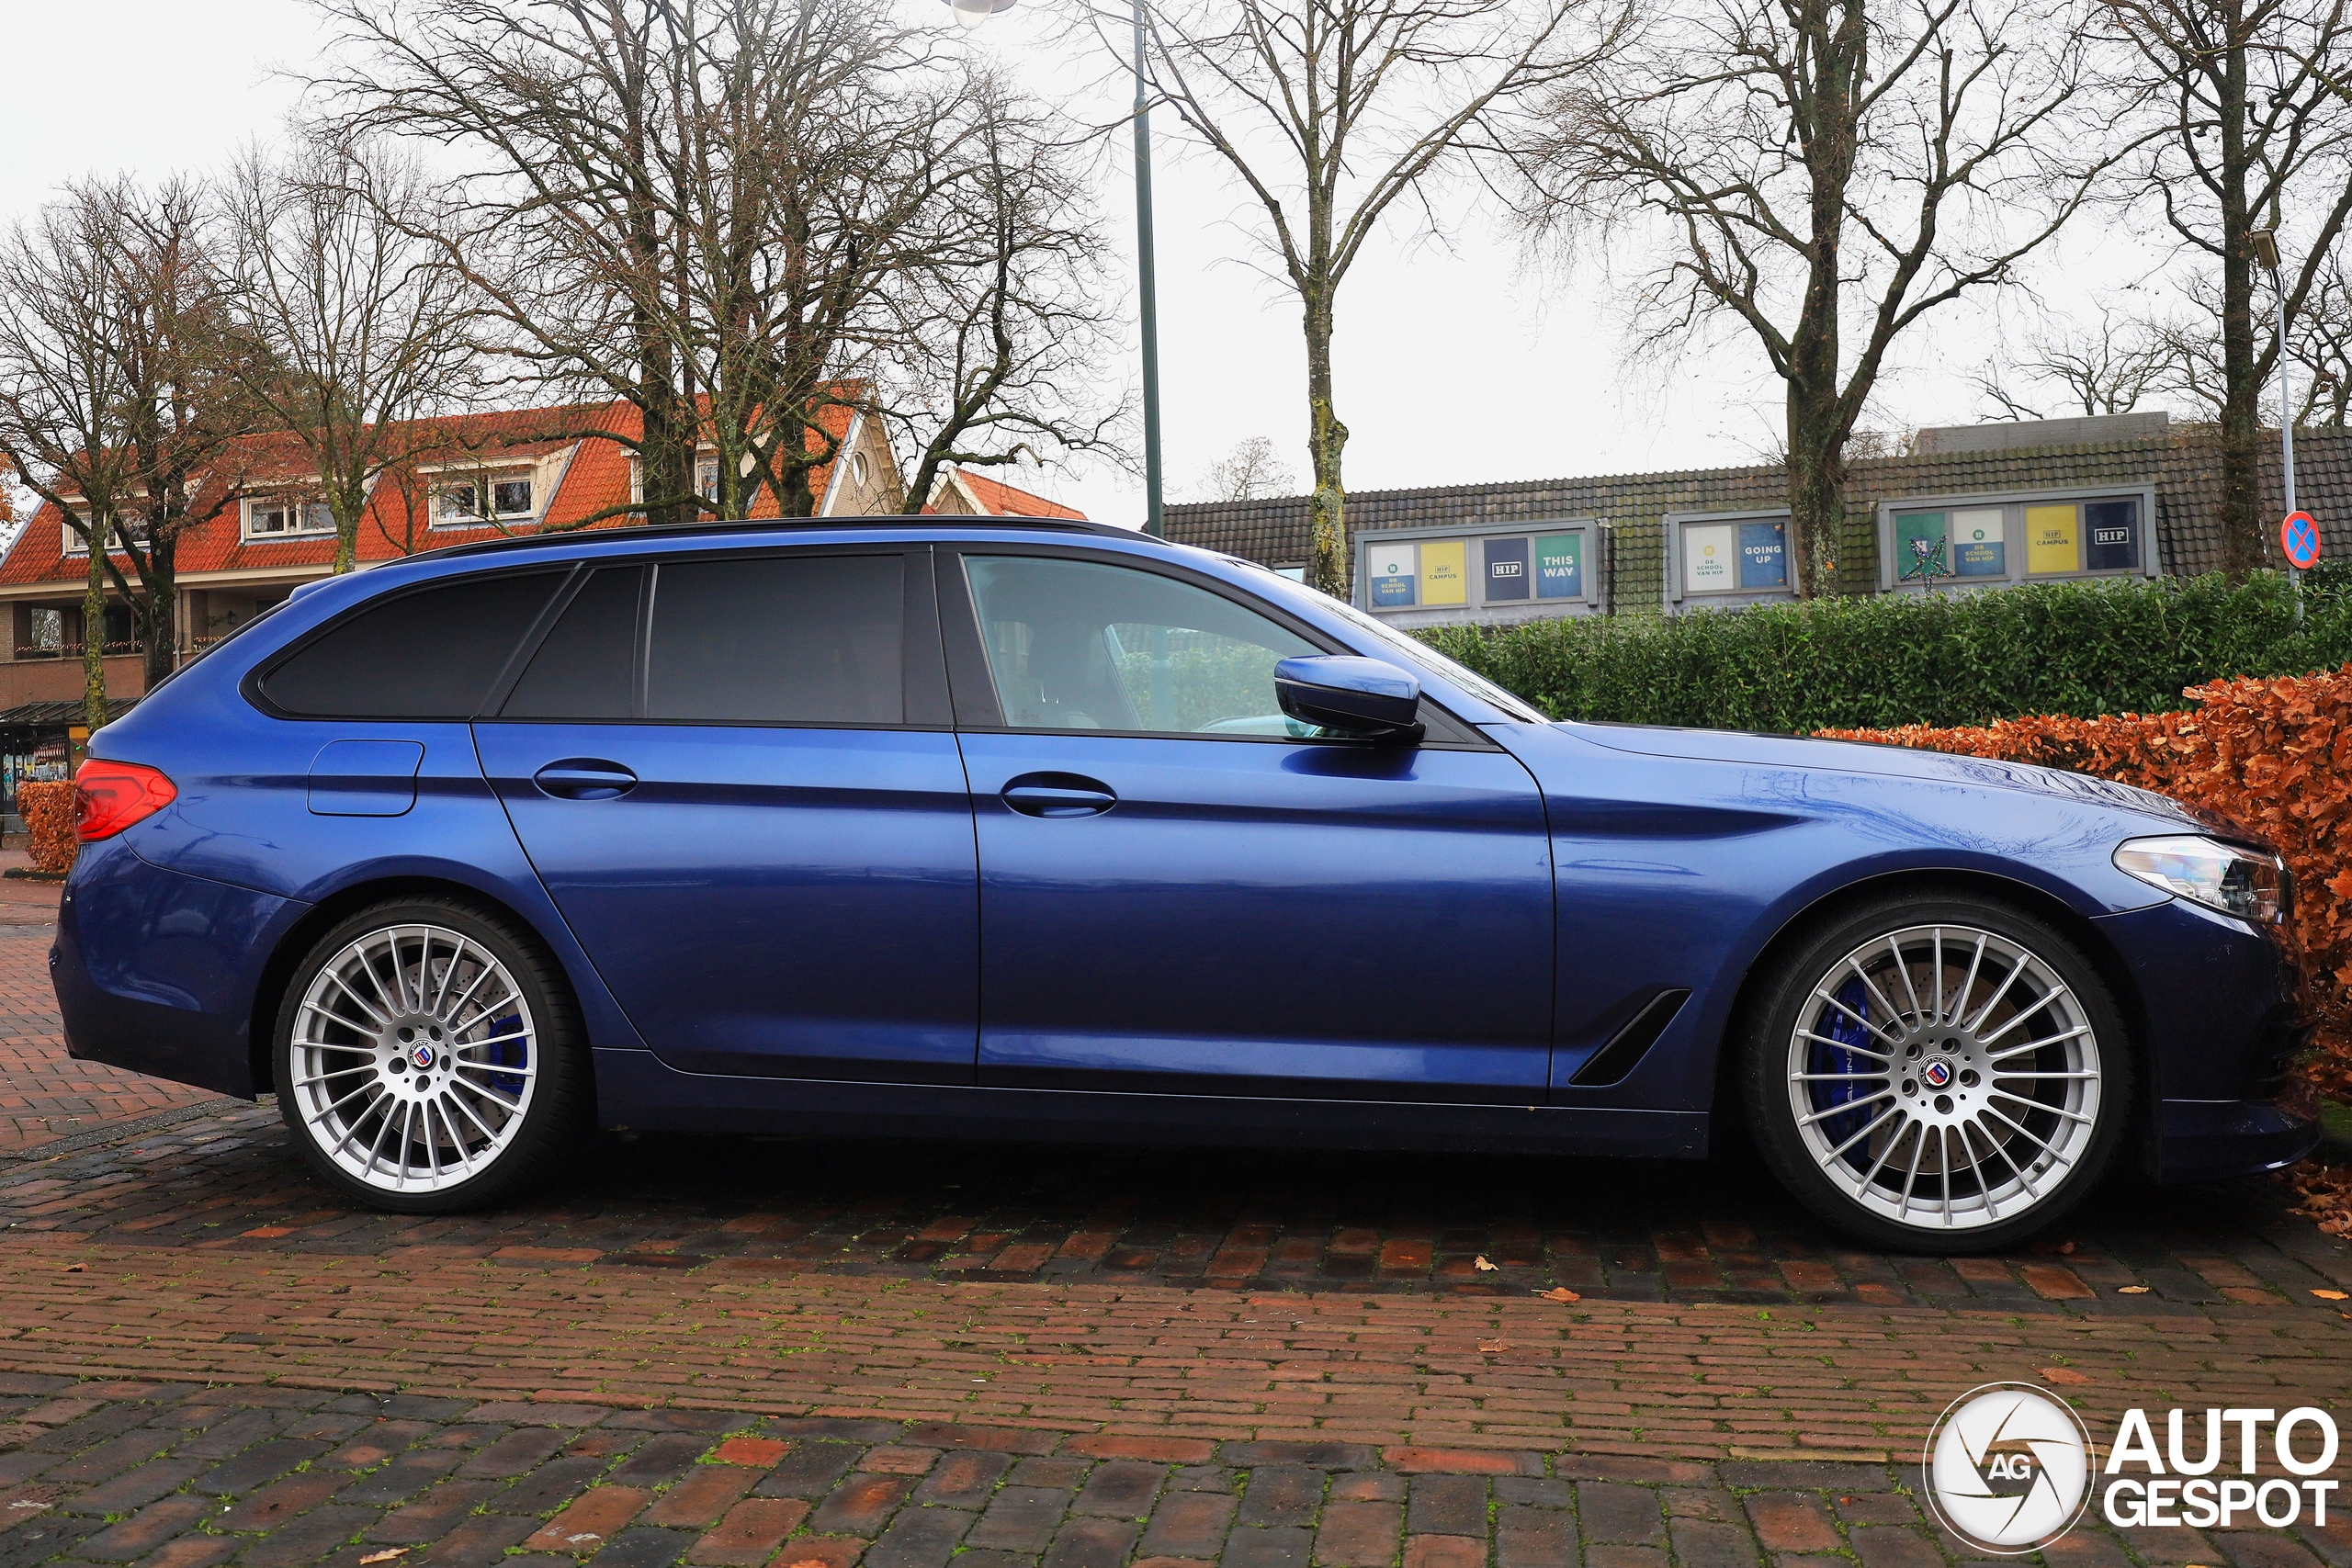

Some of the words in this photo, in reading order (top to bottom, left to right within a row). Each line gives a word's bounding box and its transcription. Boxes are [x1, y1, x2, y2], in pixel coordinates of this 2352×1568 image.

[2098, 531, 2125, 541] HIP
[1745, 545, 1781, 555] GOING
[1543, 555, 1574, 566] THIS
[1756, 556, 1771, 564] UP
[1495, 565, 1519, 575] HIP
[1544, 567, 1574, 578] WAY
[1921, 1056, 1949, 1085] ALPINA
